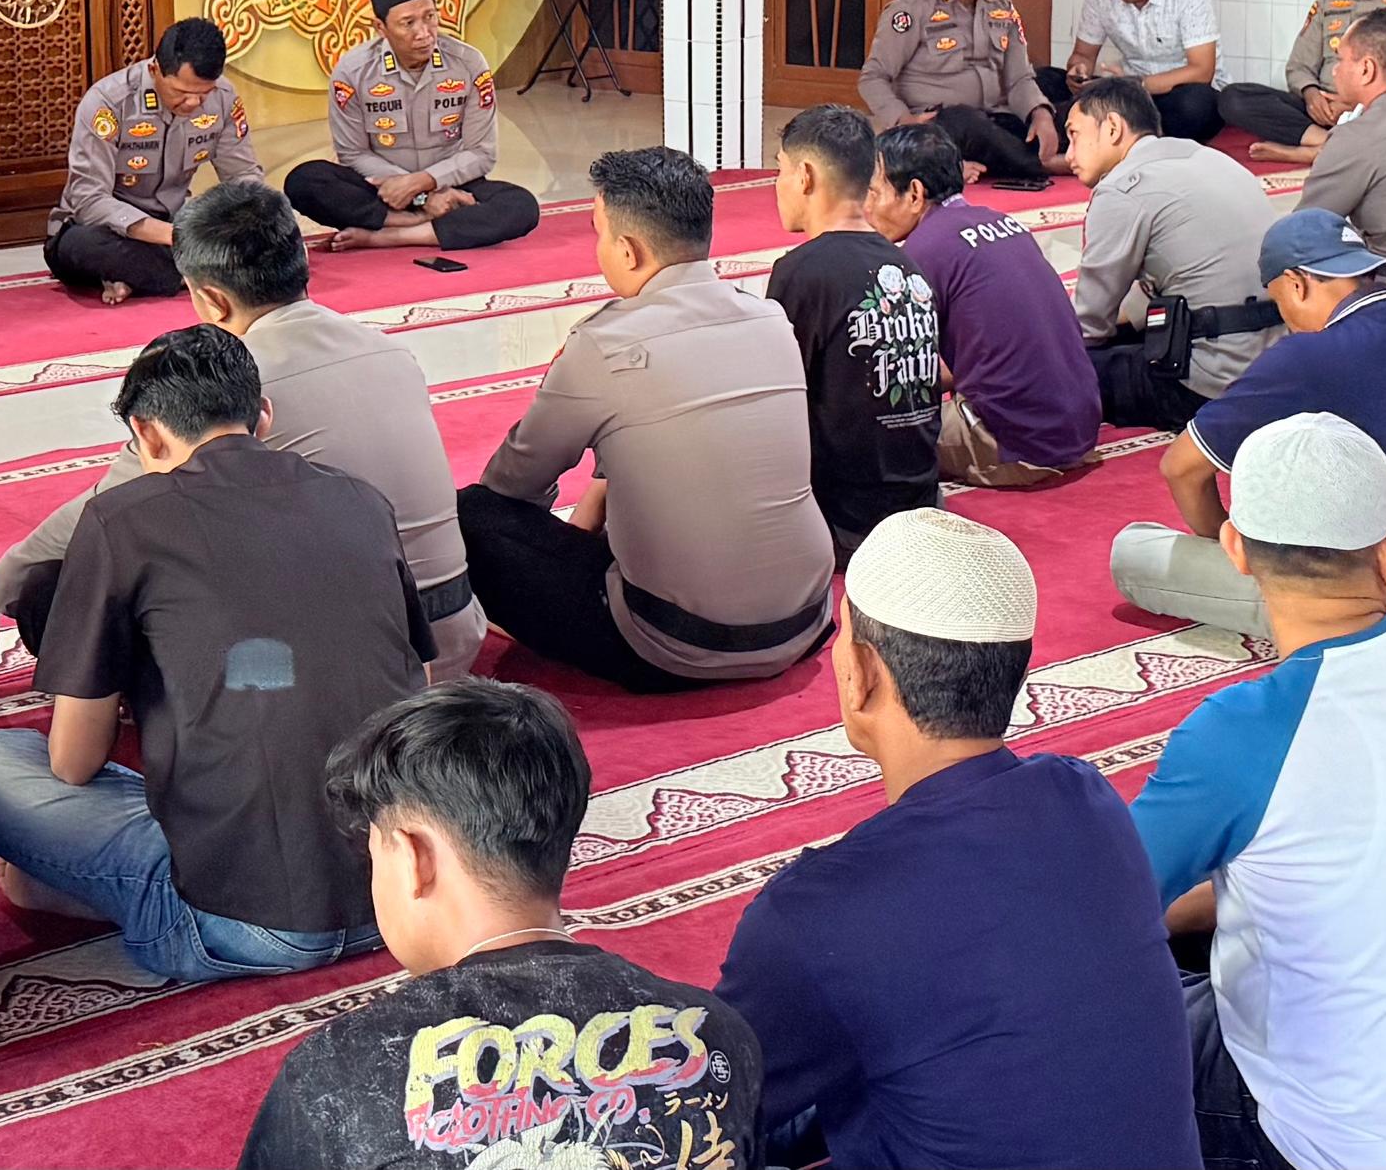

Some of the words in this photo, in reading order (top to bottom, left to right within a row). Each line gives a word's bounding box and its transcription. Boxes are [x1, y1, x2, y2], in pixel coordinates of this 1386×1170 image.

[365, 99, 403, 113] TEGUH
[872, 342, 939, 397] Faith
[405, 1004, 709, 1130] FORCES
[664, 1091, 729, 1116] ラーメン
